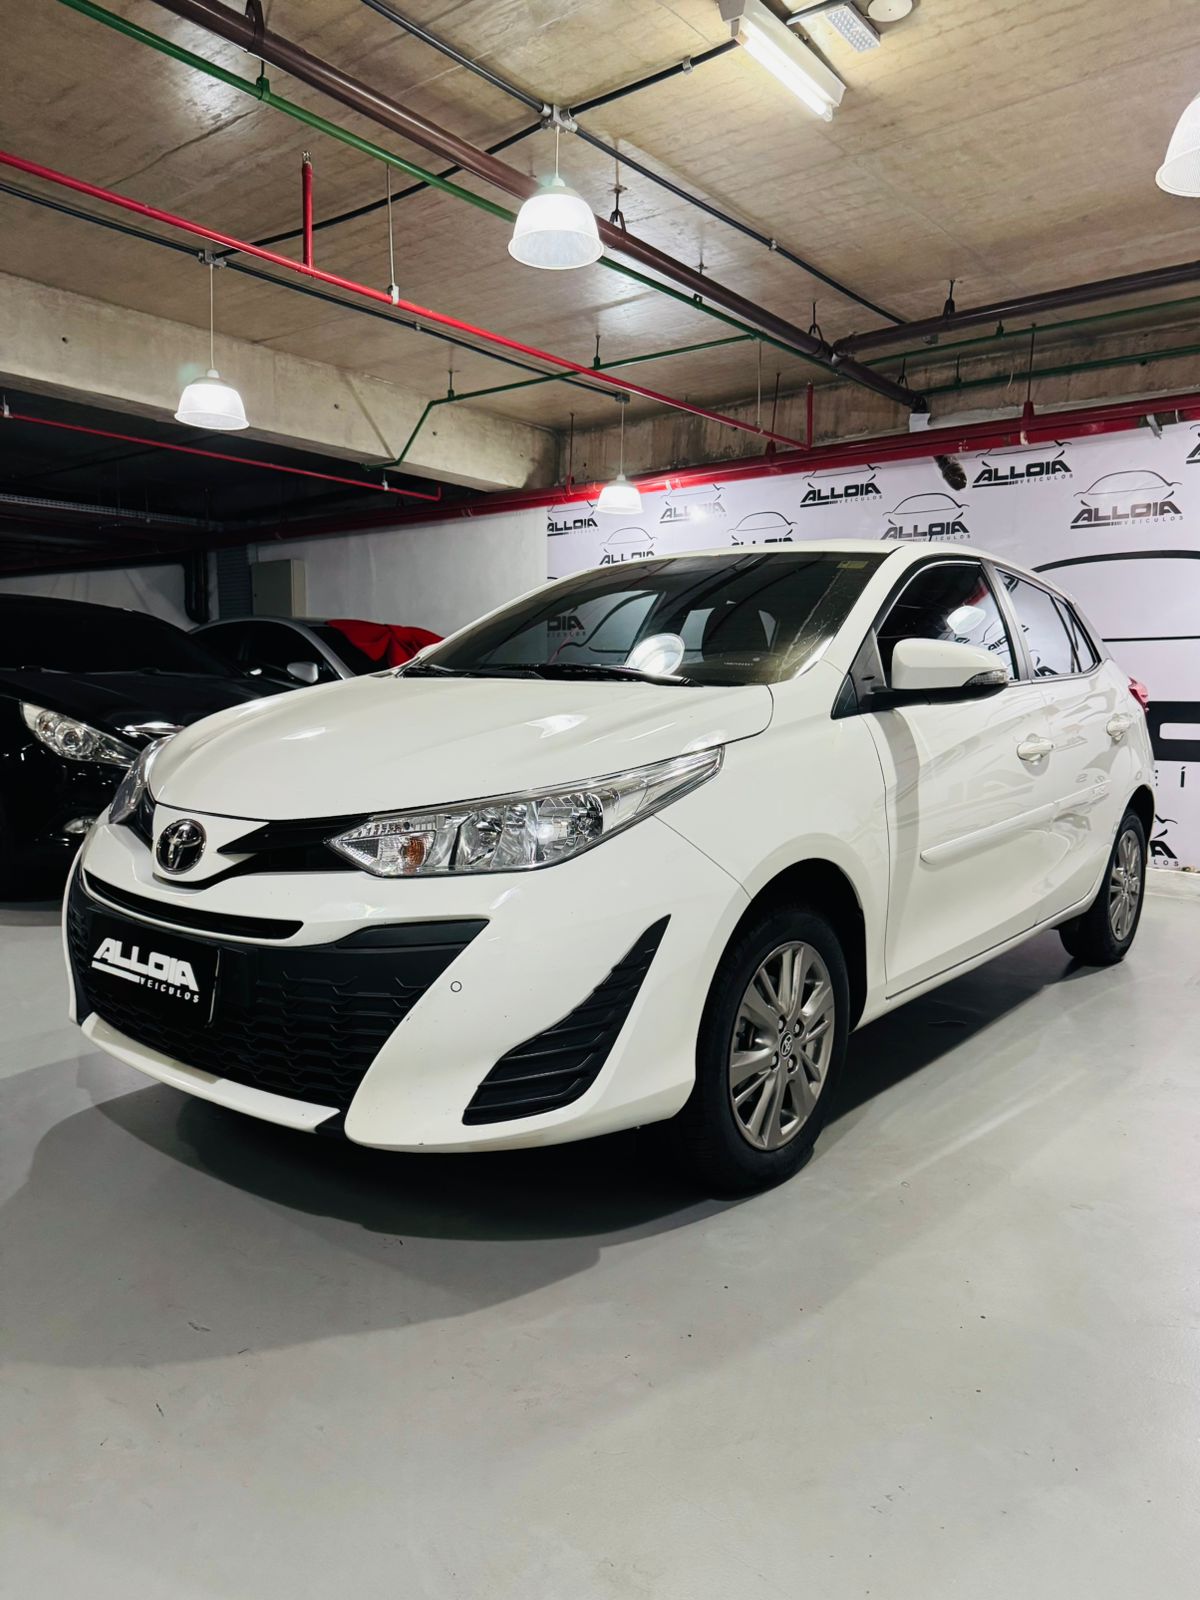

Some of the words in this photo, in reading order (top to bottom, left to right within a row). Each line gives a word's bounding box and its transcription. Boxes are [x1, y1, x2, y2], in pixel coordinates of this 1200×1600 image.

[973, 460, 1072, 484] ALLOIA
[800, 482, 881, 503] ALLOIA
[1071, 501, 1182, 524] ALLOIA
[880, 521, 970, 540] ALLOIA
[93, 937, 200, 992] ALLOIA
[140, 976, 200, 1004] VEICULOS
